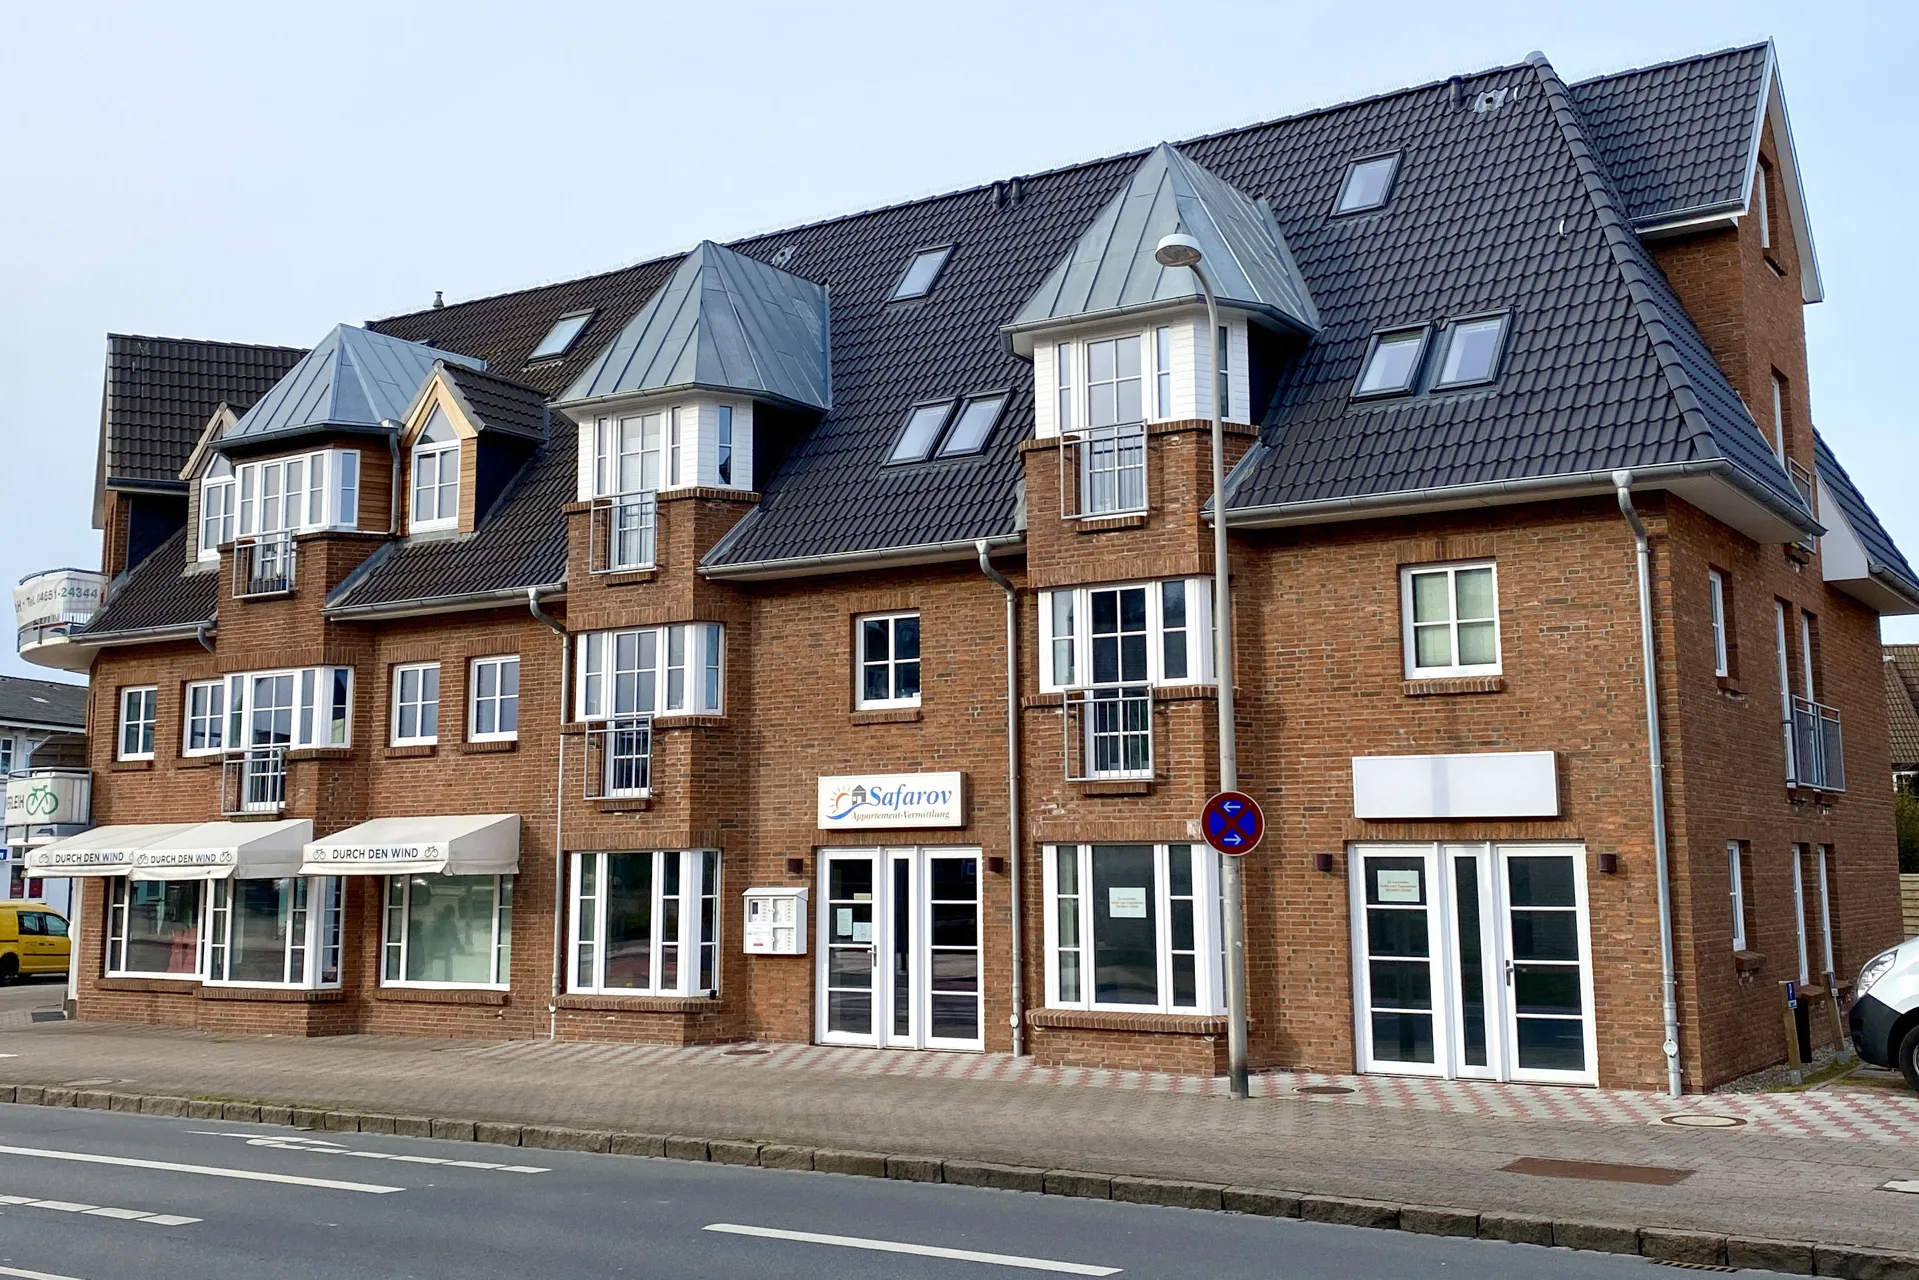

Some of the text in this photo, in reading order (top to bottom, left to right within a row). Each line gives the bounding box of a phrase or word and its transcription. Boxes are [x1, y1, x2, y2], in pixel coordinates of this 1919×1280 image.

[870, 784, 952, 811] Safarov
[852, 809, 950, 821] Appartement-Vermittlung
[55, 851, 124, 863] DURCH DEN WIND
[150, 853, 216, 864] DURCH DEN WIND
[332, 847, 418, 859] DURCH DEN WIND
